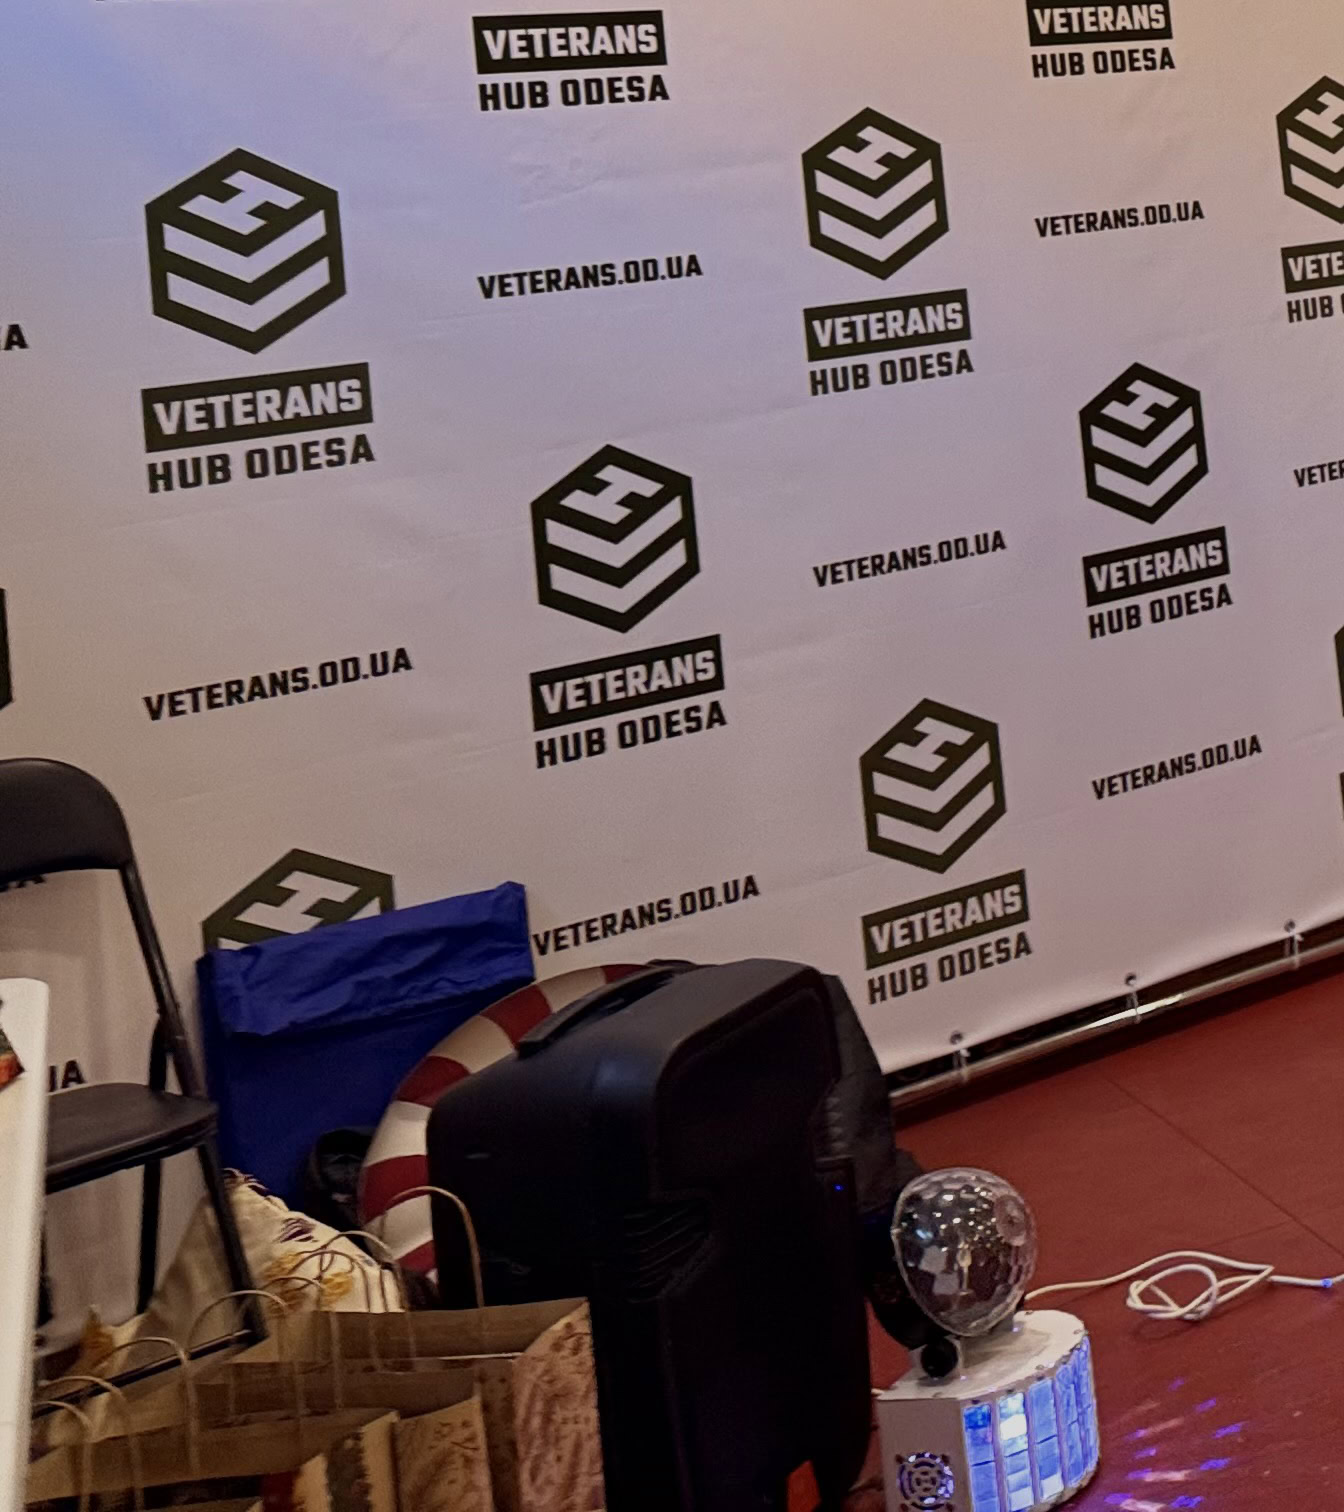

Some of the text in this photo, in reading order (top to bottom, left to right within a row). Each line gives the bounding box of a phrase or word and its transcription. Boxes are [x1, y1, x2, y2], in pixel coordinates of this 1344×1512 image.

[483, 24, 657, 59] VETERANS
[1034, 4, 1165, 34] VETERANS
[1032, 47, 1175, 78] HUB ODESA
[479, 75, 669, 111] HUB ODESA
[1035, 201, 1204, 237] VETERANS.OD.UA
[478, 255, 702, 299] VETERANS.OD.UA
[812, 303, 963, 347] VETERANS
[1287, 296, 1333, 323] HUB
[810, 349, 974, 396] HUB ODESA
[153, 379, 363, 435] VETERANS
[148, 434, 375, 493] HUB ODESA
[813, 531, 1006, 587] VETERANS.OD.UA
[1091, 540, 1222, 592] VETERANS
[1089, 583, 1232, 639] HUB ODESA
[143, 648, 412, 721] VETERANS.OD.UA
[540, 650, 717, 718] VETERANS
[536, 701, 727, 768] HUB ODESA
[1092, 735, 1262, 800] VETERANS.OD.UA
[532, 875, 760, 956] VETERANS.OD.UA
[871, 885, 1024, 954] VETERANS
[868, 932, 1032, 1004] HUB ODESA
